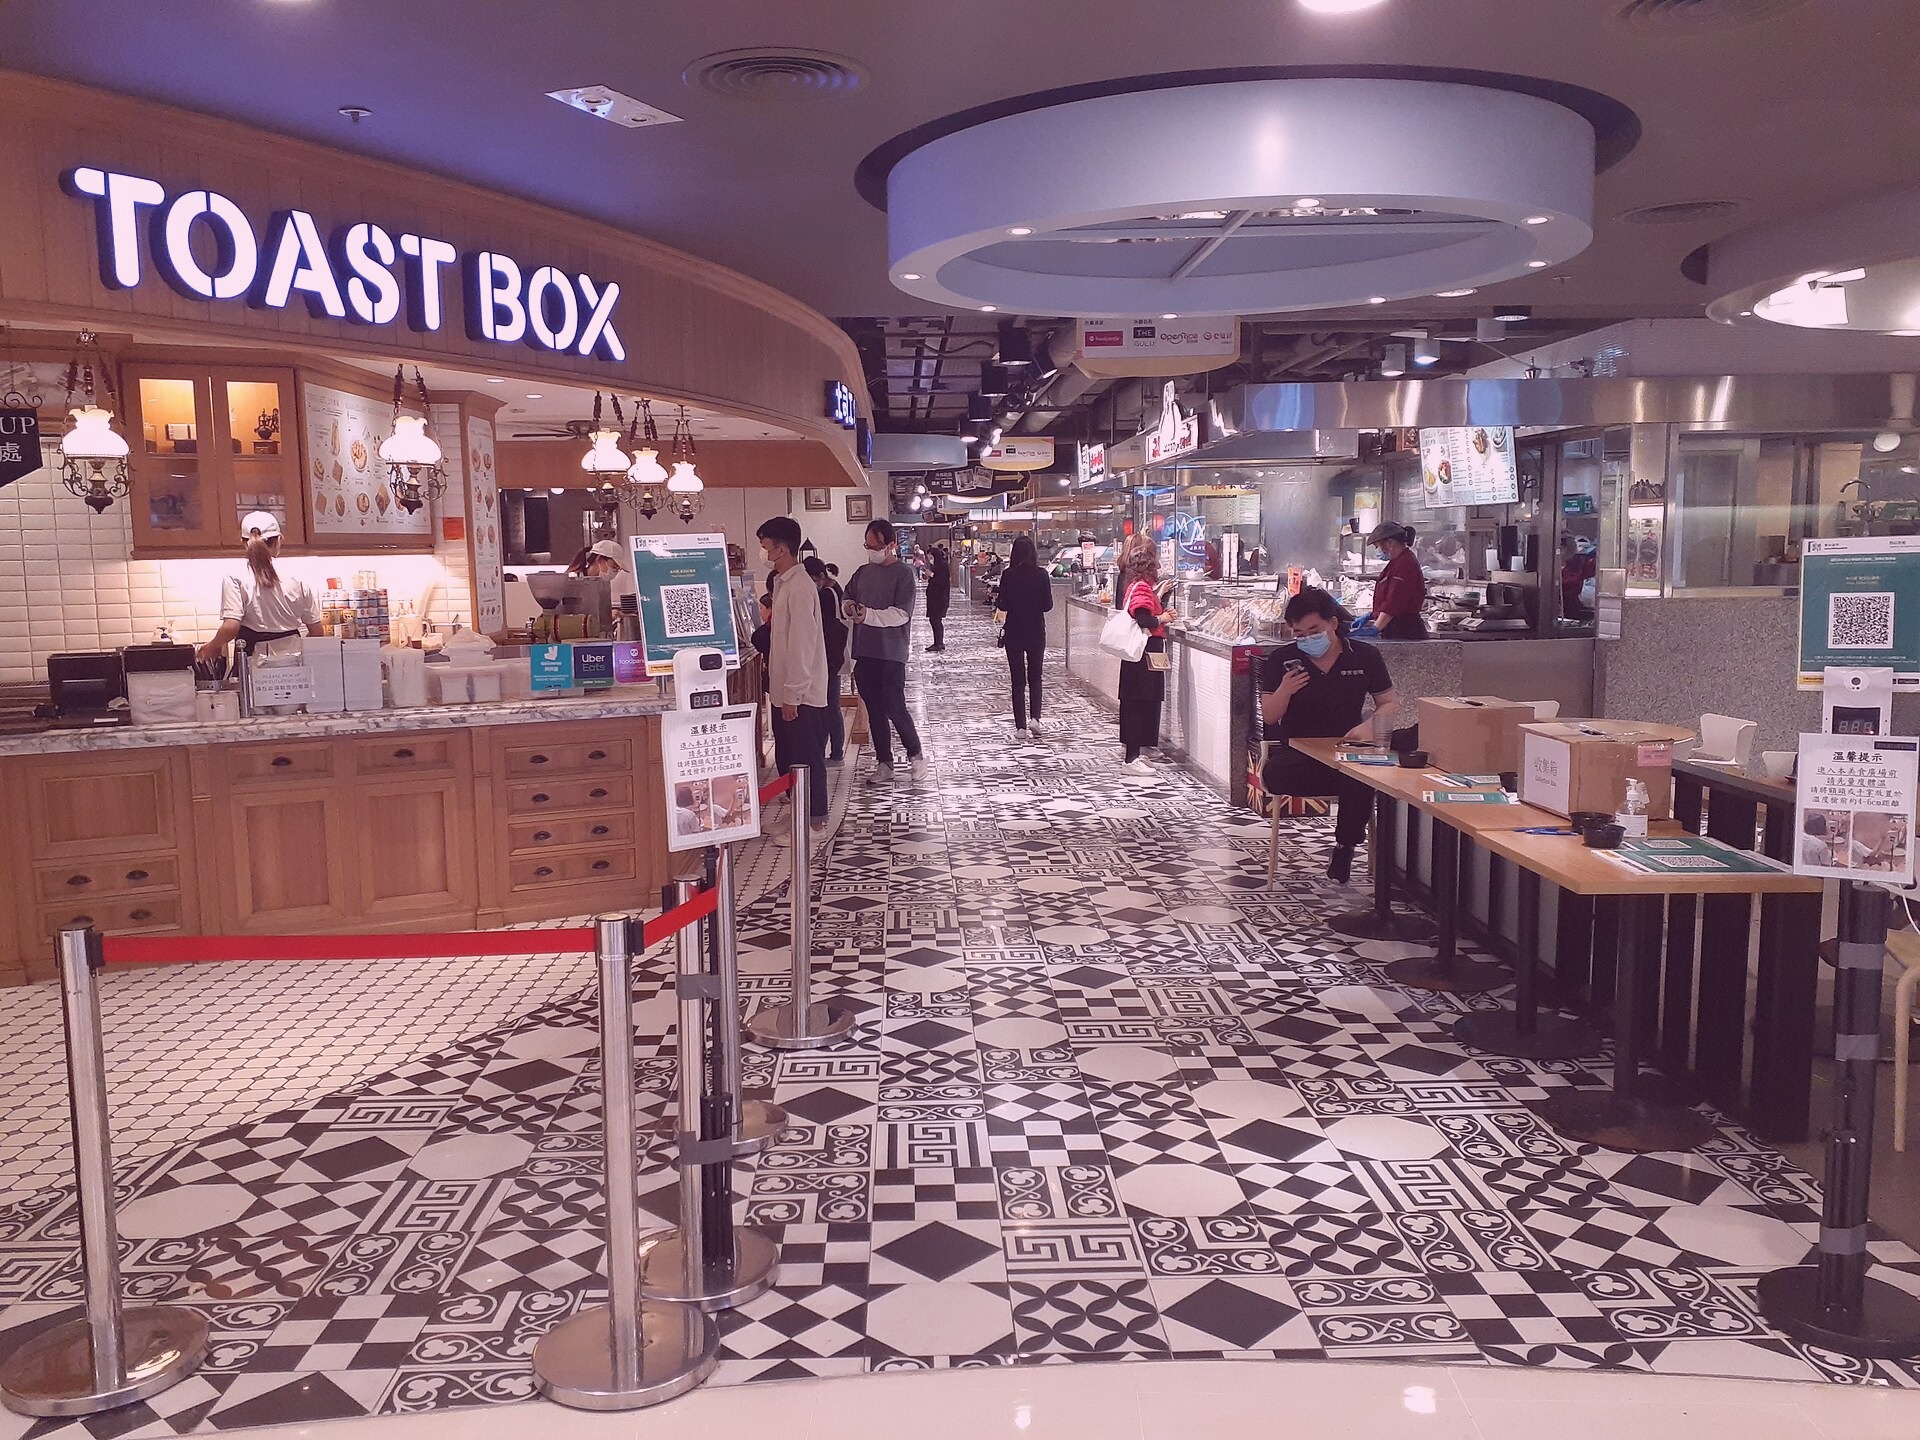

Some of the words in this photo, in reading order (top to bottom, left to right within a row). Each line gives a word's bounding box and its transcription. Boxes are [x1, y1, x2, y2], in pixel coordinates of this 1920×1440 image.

[73, 166, 457, 332] TOAST
[477, 250, 627, 361] BOX
[1136, 329, 1153, 338] THE
[0, 416, 36, 435] UP
[581, 654, 606, 663] Uber
[582, 663, 606, 672] Eats
[690, 722, 728, 735] 溫馨提示
[1832, 751, 1883, 762] 溫馨提示
[1534, 757, 1558, 776] 收集箱
